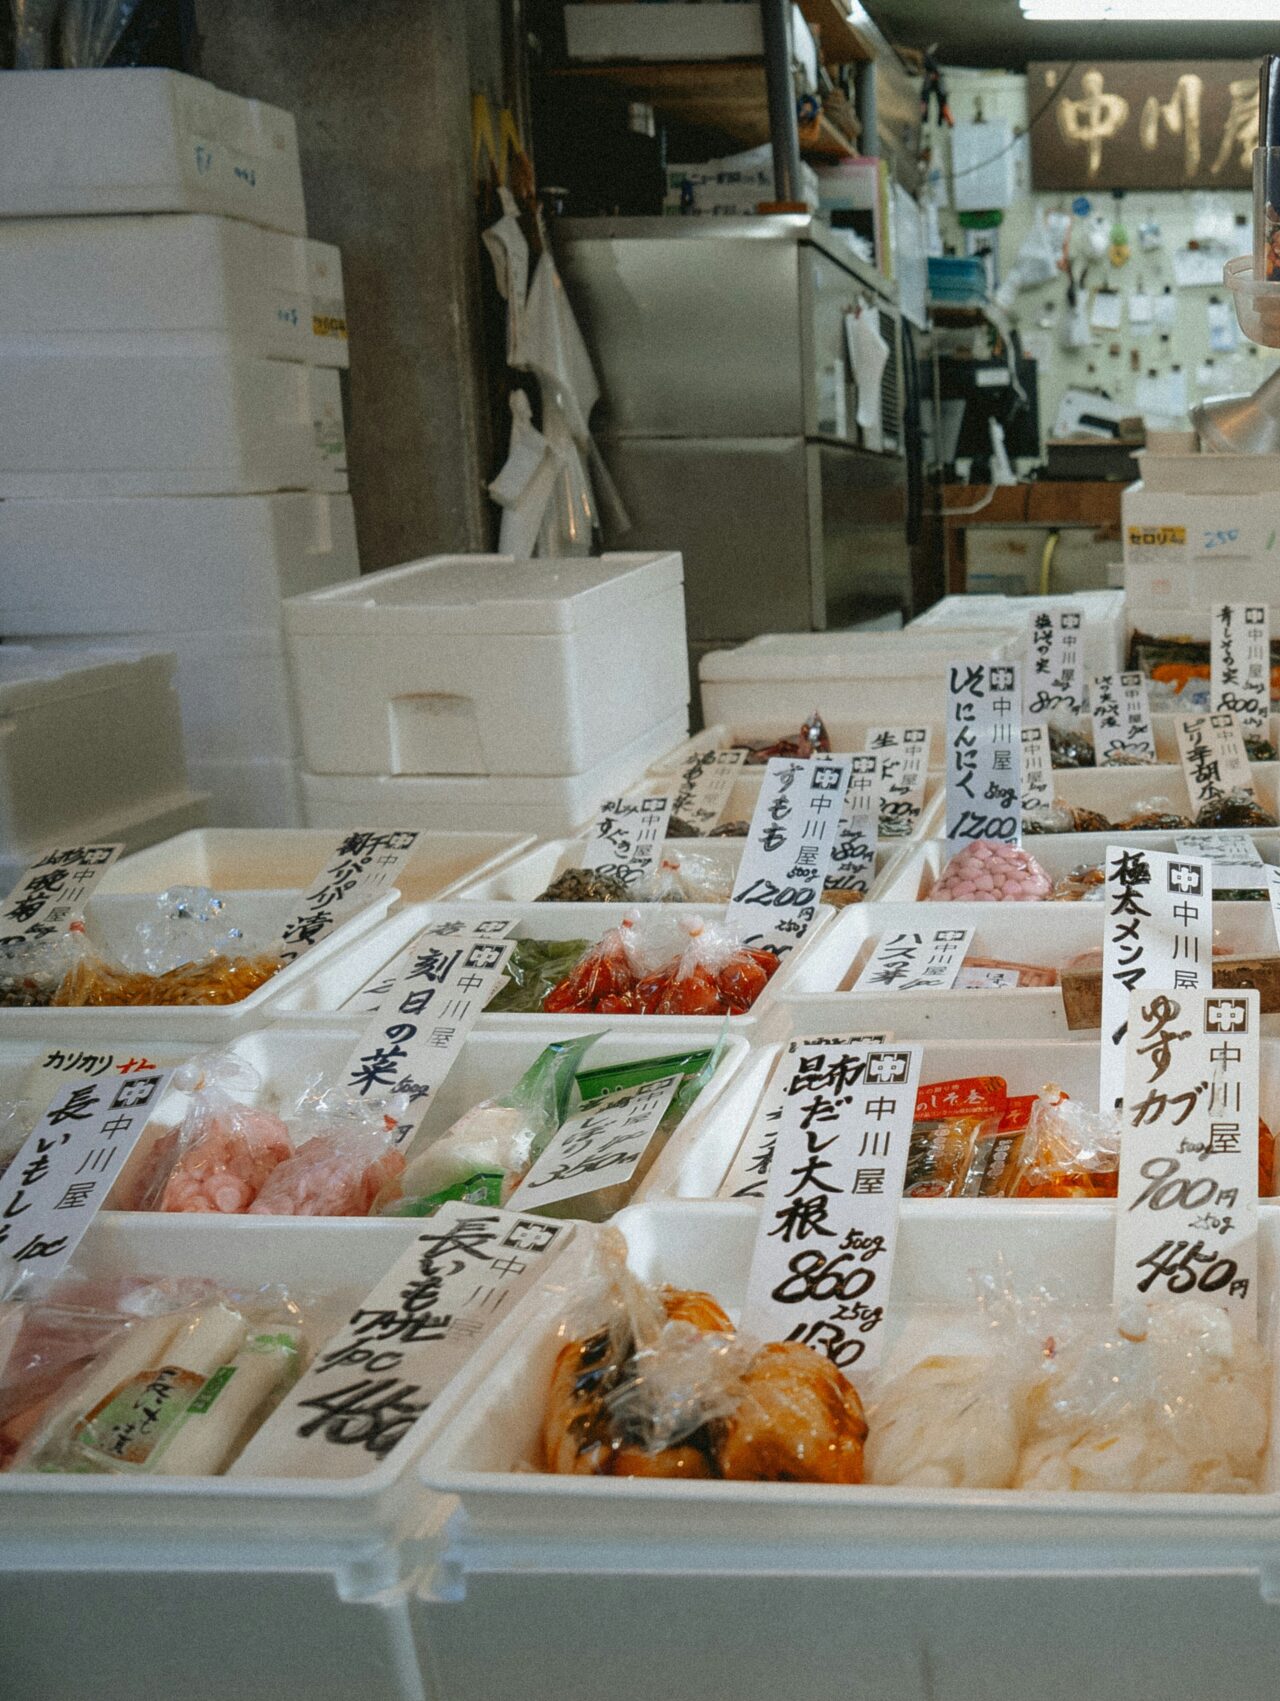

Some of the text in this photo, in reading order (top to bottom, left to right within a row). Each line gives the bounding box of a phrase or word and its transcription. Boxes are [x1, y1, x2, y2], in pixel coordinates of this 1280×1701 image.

[950, 664, 985, 799] しそにんにく
[992, 697, 1013, 771] 中川屋
[758, 762, 804, 852] すもも
[795, 794, 832, 866] 中川屋
[1108, 850, 1153, 992] 極太メンマ
[1171, 899, 1201, 989] 中川屋
[426, 973, 484, 1049] 中川屋
[43, 1050, 114, 1077] カリカリ
[1207, 1040, 1242, 1155] 中川屋
[53, 1113, 134, 1210] 中川屋
[768, 1053, 867, 1243] 昆布だし大根
[851, 1095, 897, 1196] 中川屋
[1127, 1156, 1239, 1213] 900円
[770, 1249, 877, 1304] 860
